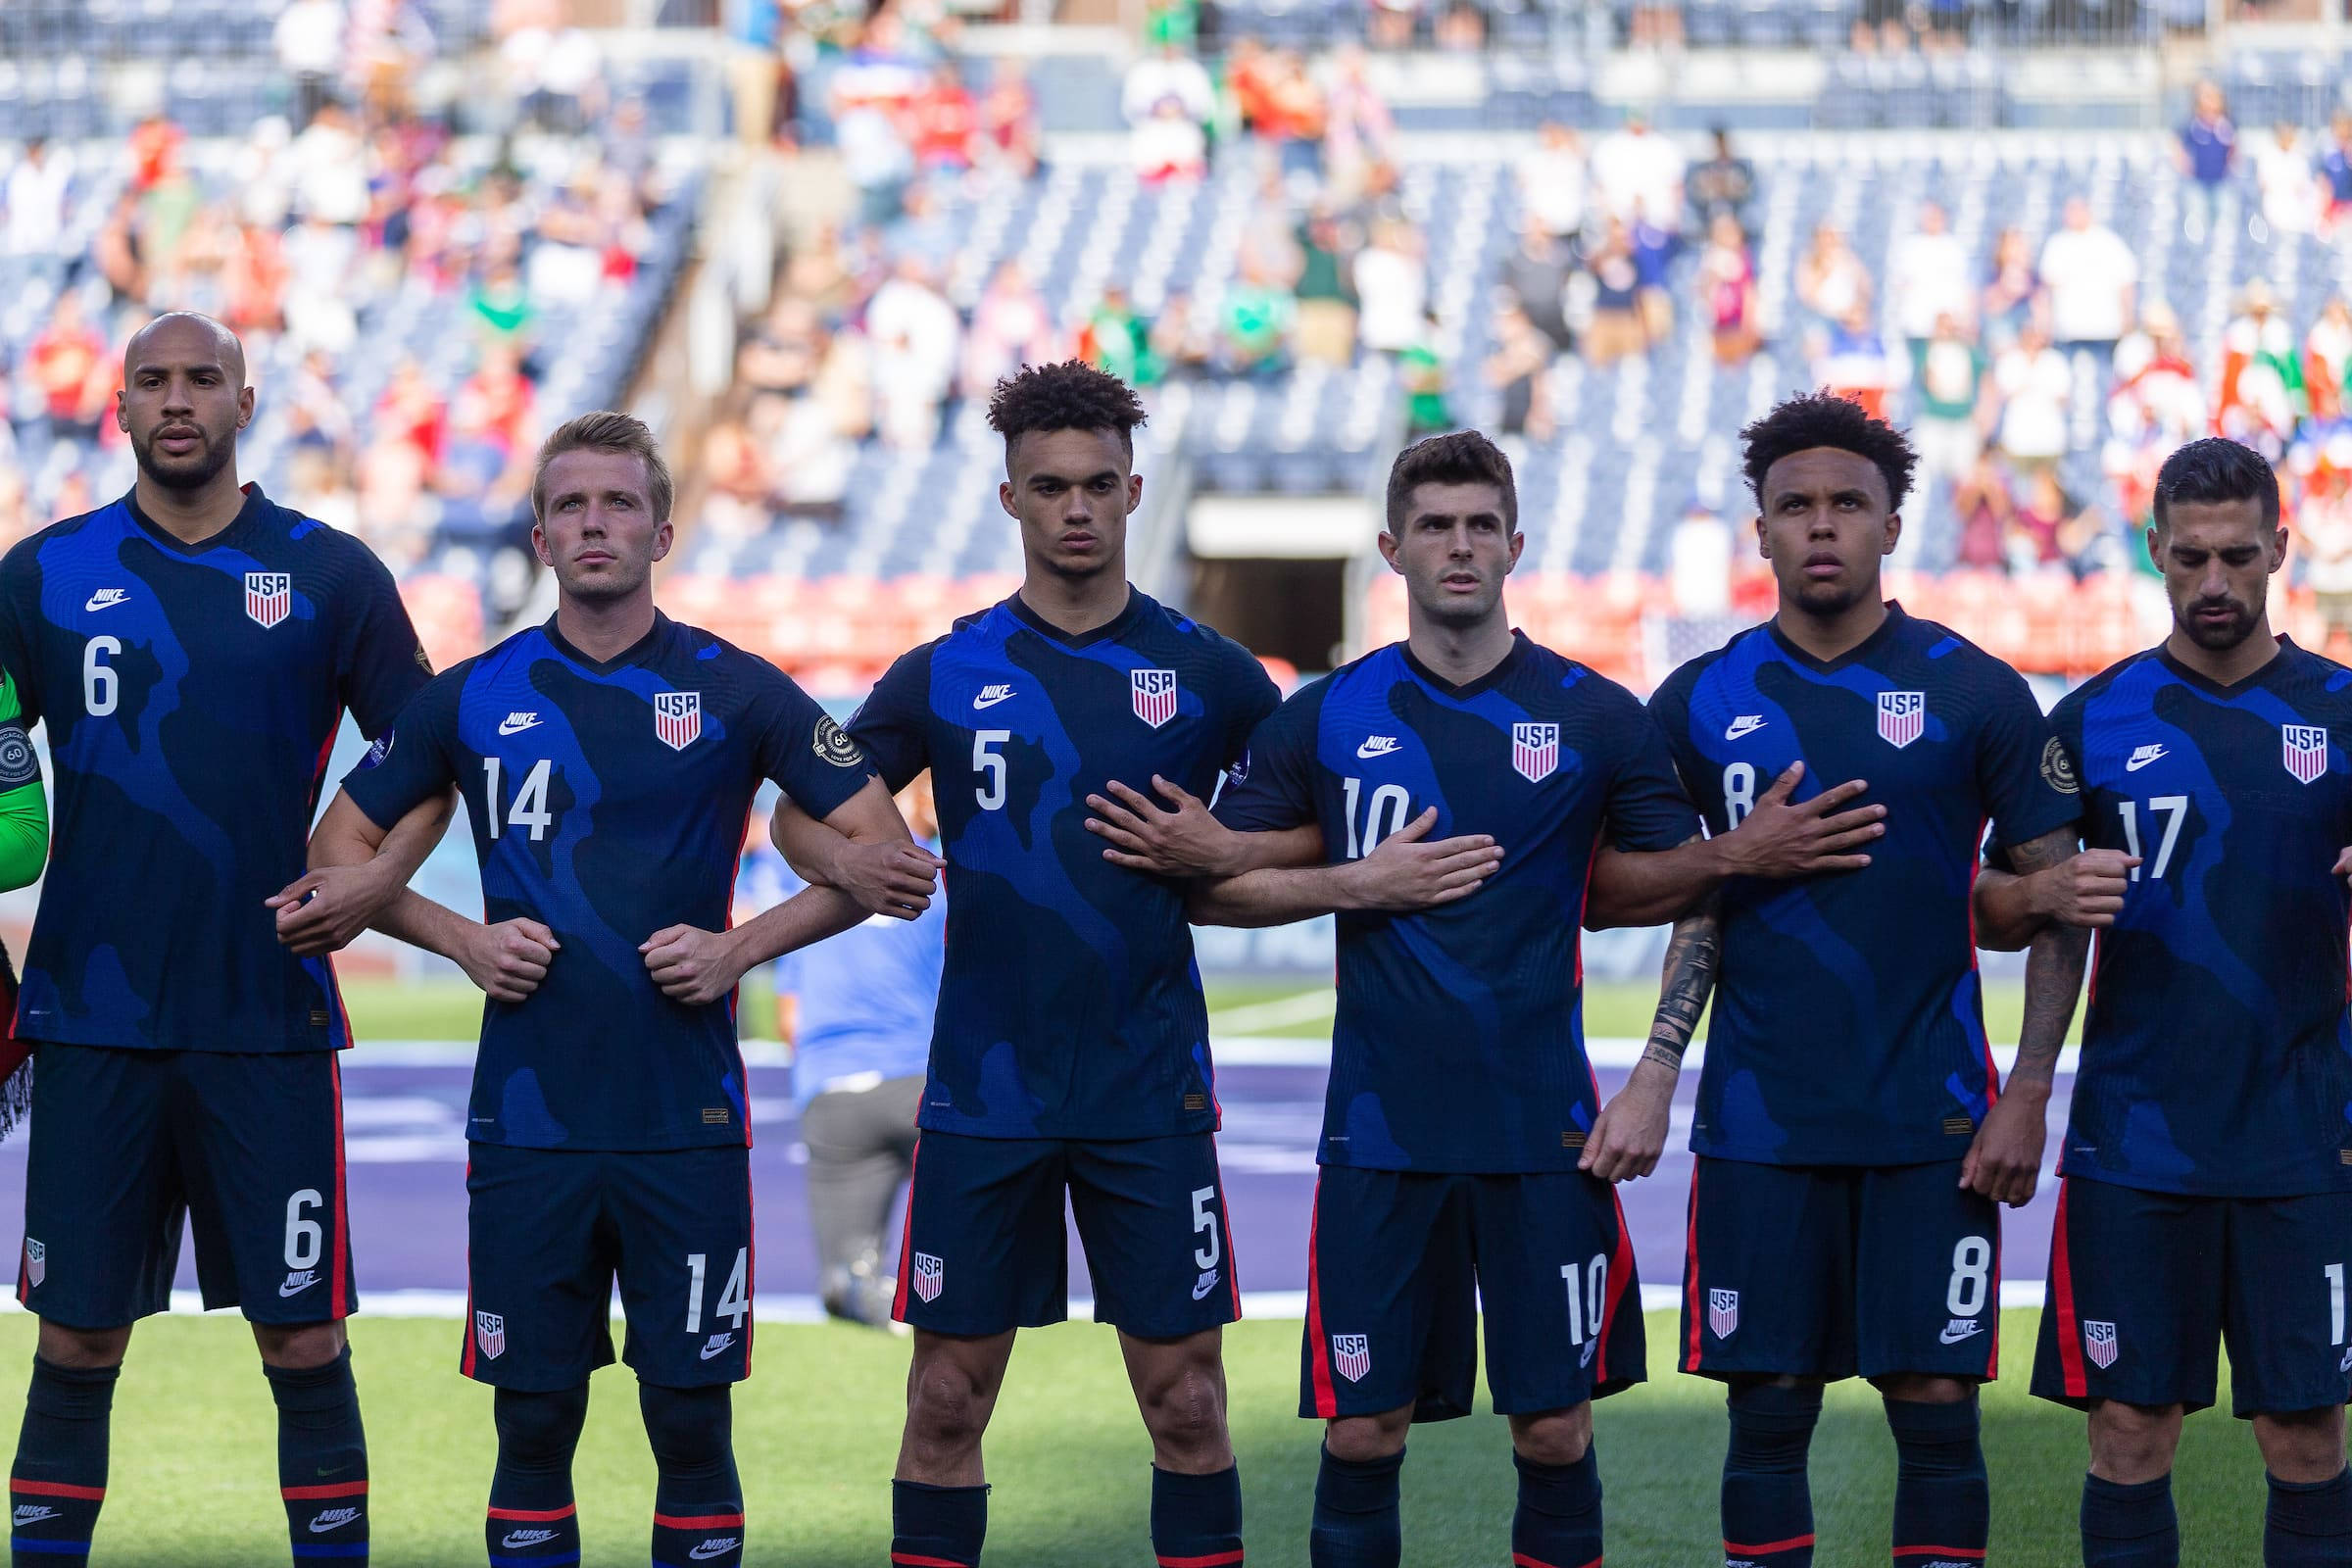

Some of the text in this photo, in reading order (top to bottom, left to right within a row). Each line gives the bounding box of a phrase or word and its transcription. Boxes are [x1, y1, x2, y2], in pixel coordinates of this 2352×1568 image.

[248, 575, 287, 596] USA
[93, 589, 125, 603] NIKE
[83, 635, 122, 716] 6
[1134, 672, 1174, 695] USA
[979, 684, 1011, 700] NIKE
[658, 696, 698, 717] USA
[1882, 694, 1921, 715] USA
[505, 712, 538, 726] NIKE
[1733, 714, 1762, 730] NIKE
[835, 733, 848, 746] 60
[1365, 735, 1398, 752] NIKE
[1516, 725, 1556, 749] USA
[2286, 727, 2324, 751] USA
[8, 748, 22, 760] 60
[2132, 744, 2163, 760] NIKE
[973, 729, 1011, 810] 5
[483, 757, 552, 841] 14
[1722, 762, 1757, 831] 8
[1343, 777, 1410, 858] 10
[2119, 796, 2188, 881] 17
[284, 1189, 322, 1269] 6
[1192, 1185, 1219, 1269] 5
[27, 1240, 44, 1260] USA
[916, 1253, 941, 1274] USA
[285, 1270, 315, 1287] NIKE
[1198, 1269, 1217, 1289] NIKE
[1946, 1236, 1990, 1316] 8
[686, 1247, 749, 1333] 14
[1560, 1252, 1607, 1346] 10
[1712, 1291, 1736, 1310] USA
[2325, 1263, 2344, 1346] 1
[478, 1311, 502, 1334] USA
[1948, 1320, 1977, 1334] NIKE
[2086, 1323, 2113, 1342] USA
[707, 1333, 732, 1348] NIKE
[1335, 1337, 1365, 1354] USA
[15, 1505, 52, 1517] NIKE
[318, 1507, 357, 1522] NIKE
[513, 1530, 552, 1541] NIKE
[701, 1538, 737, 1550] NIKE
